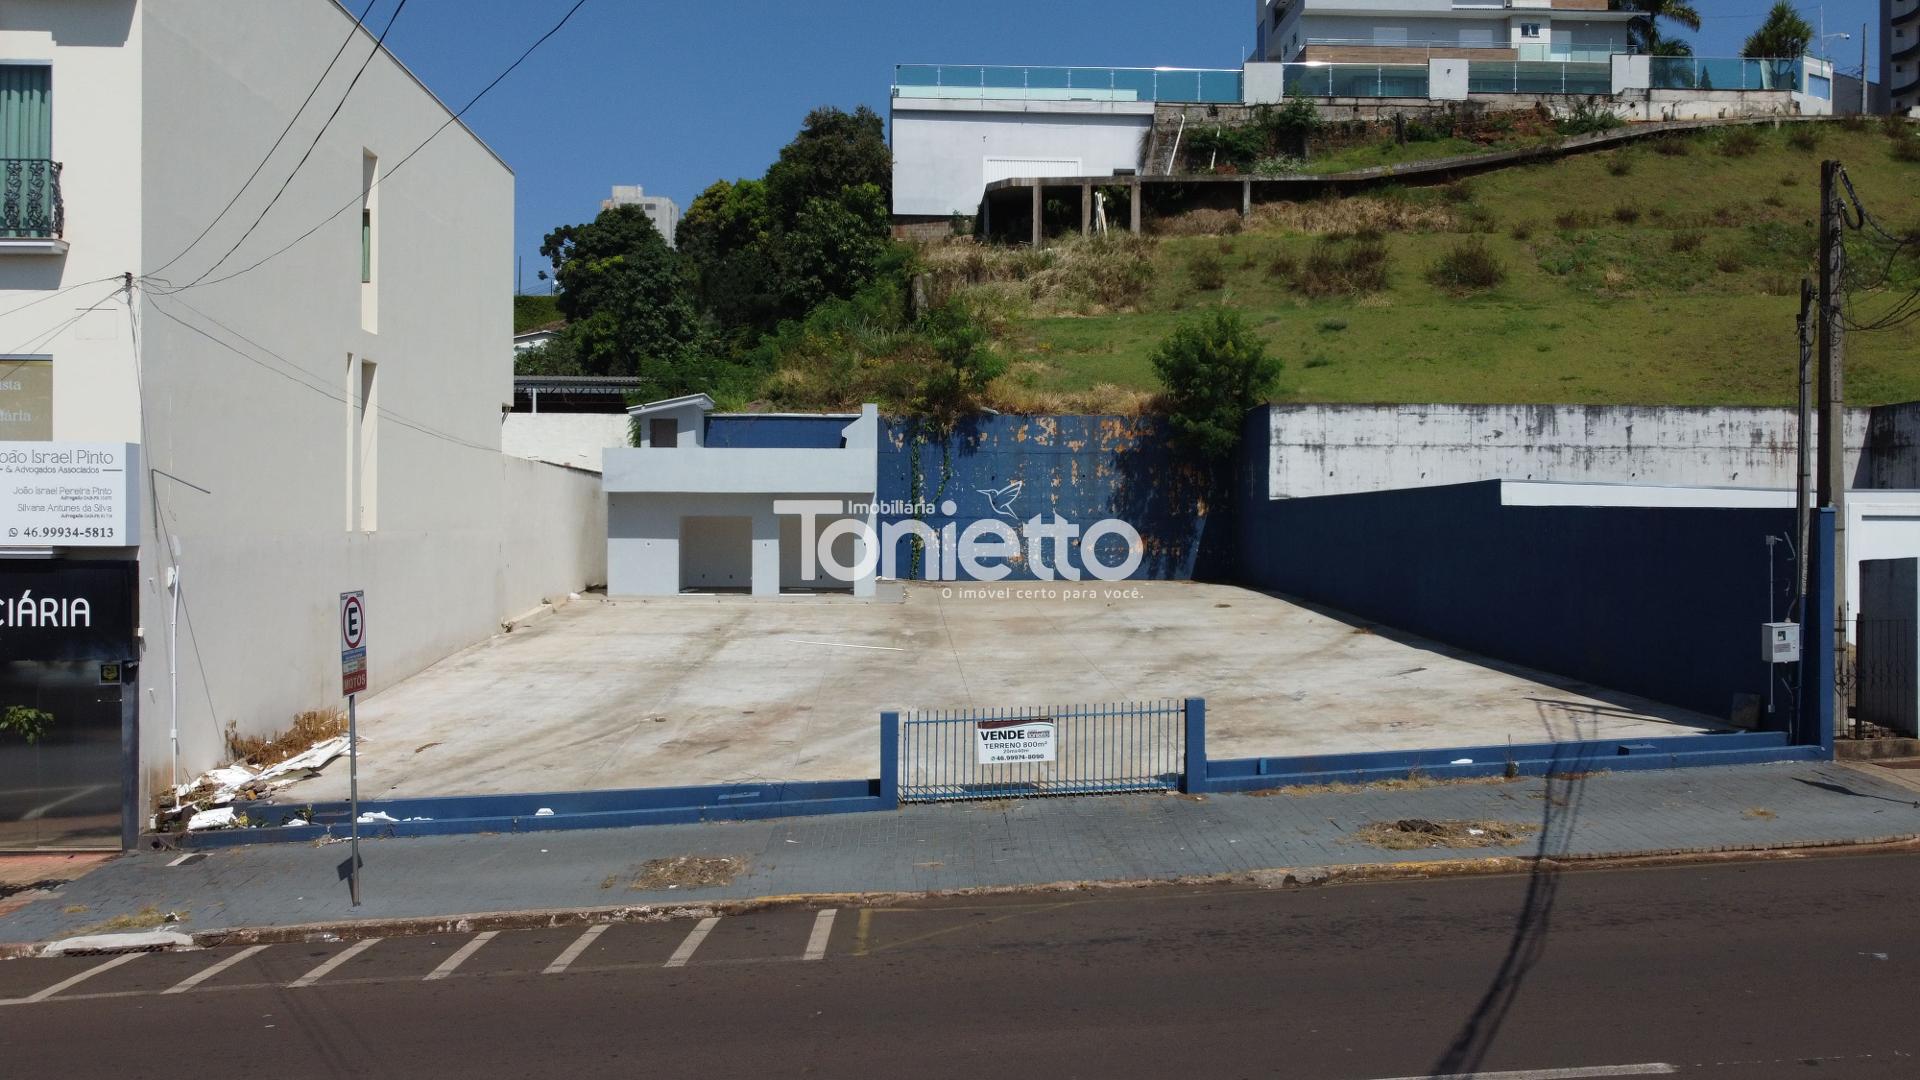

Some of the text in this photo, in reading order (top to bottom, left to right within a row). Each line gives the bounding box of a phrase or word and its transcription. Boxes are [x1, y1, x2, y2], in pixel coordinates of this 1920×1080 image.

[31, 449, 72, 464] Israel
[77, 449, 114, 464] Pinto
[6, 465, 100, 475] & Advogados Associados
[13, 486, 34, 495] João
[92, 487, 112, 495] Pinto
[17, 503, 112, 512] Silvana Antunes da Silva
[24, 527, 114, 538] 46.99934-5813
[0, 589, 90, 627] IÁRIA
[348, 607, 358, 636] E
[344, 673, 366, 689] MOTOS
[980, 729, 1025, 740] VENDE
